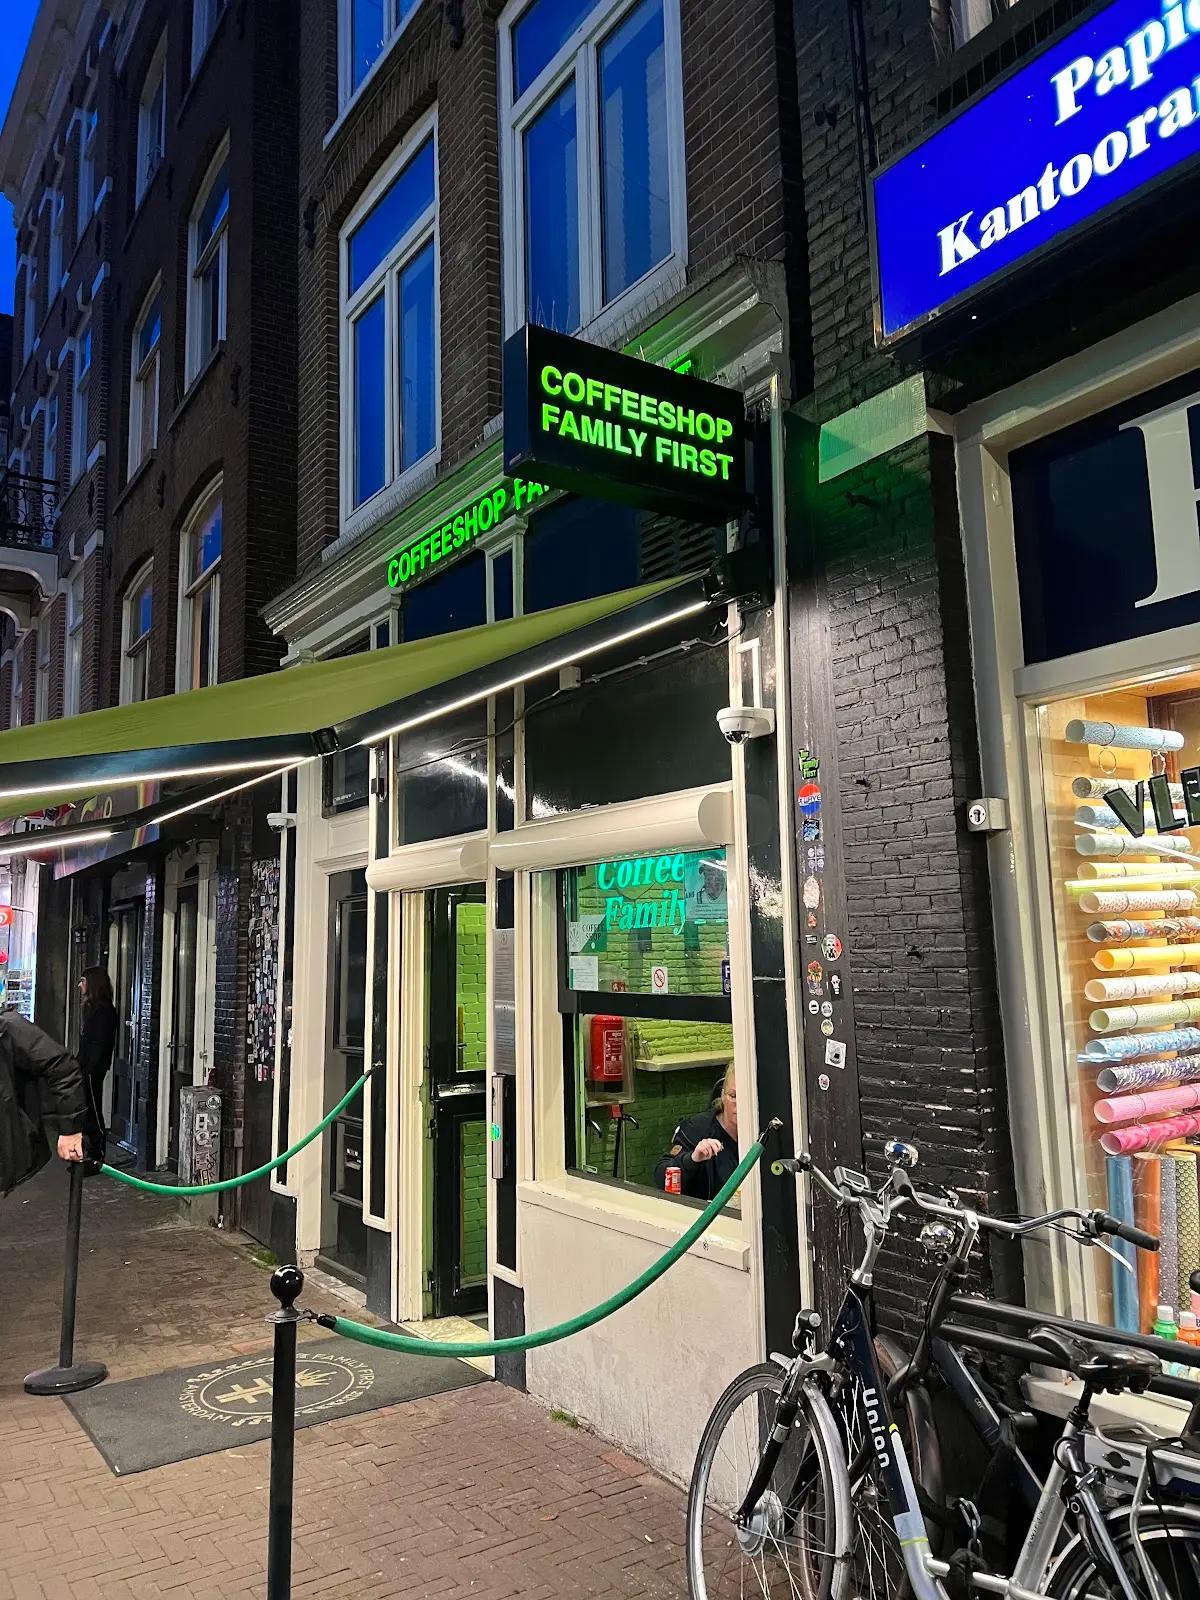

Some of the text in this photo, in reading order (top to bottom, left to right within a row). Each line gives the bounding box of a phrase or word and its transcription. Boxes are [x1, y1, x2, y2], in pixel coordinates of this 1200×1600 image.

[938, 74, 1200, 276] Kantoora
[541, 365, 733, 443] COFFEESHOP
[542, 403, 733, 480] FAMILY FIRST
[388, 489, 505, 587] COFFEESHOP
[598, 853, 684, 889] Coffee
[605, 889, 685, 935] Family
[179, 1384, 232, 1421] AMSTERDAM
[312, 1353, 368, 1369] FAMILY
[357, 1368, 374, 1389] FIRST
[863, 1388, 889, 1468] Union
